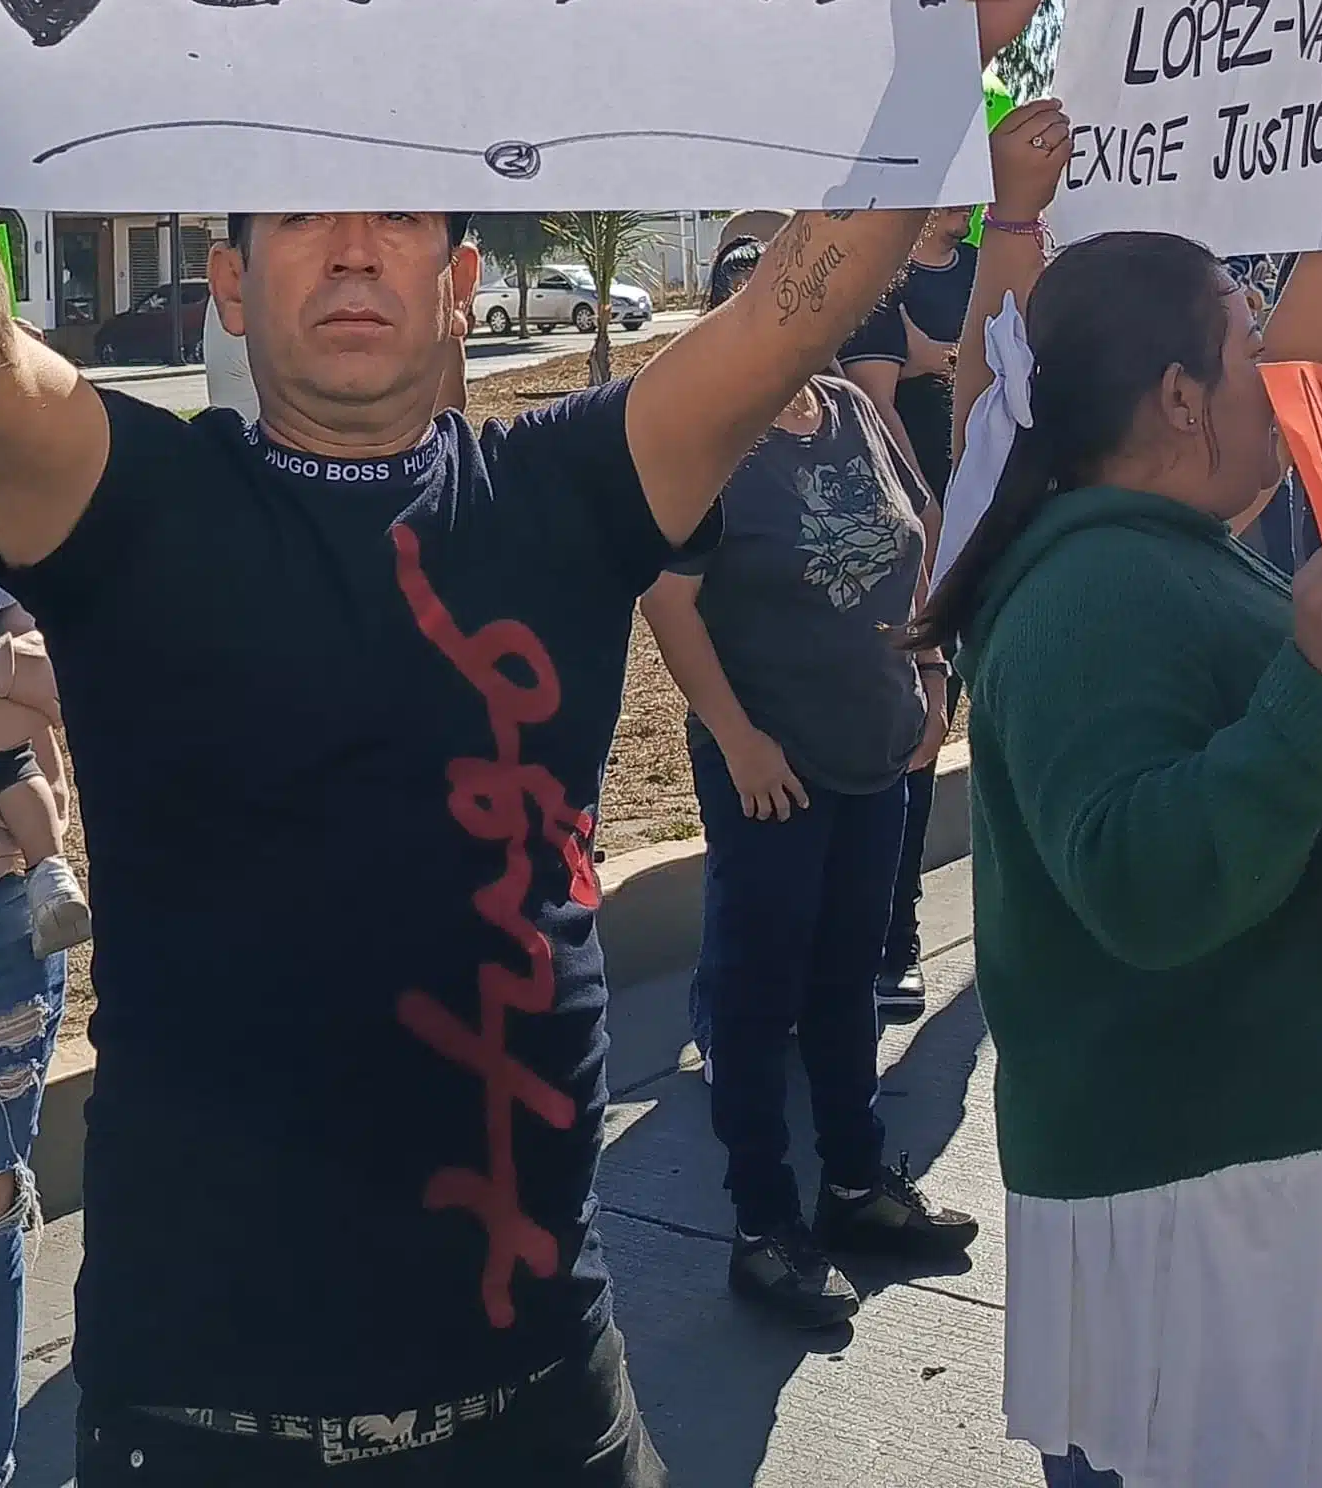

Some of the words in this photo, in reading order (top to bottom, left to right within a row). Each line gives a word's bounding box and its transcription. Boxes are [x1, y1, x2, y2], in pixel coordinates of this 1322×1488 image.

[1067, 115, 1188, 190] EXIGE
[265, 447, 319, 477] HUGO
[326, 463, 390, 481] BOSS
